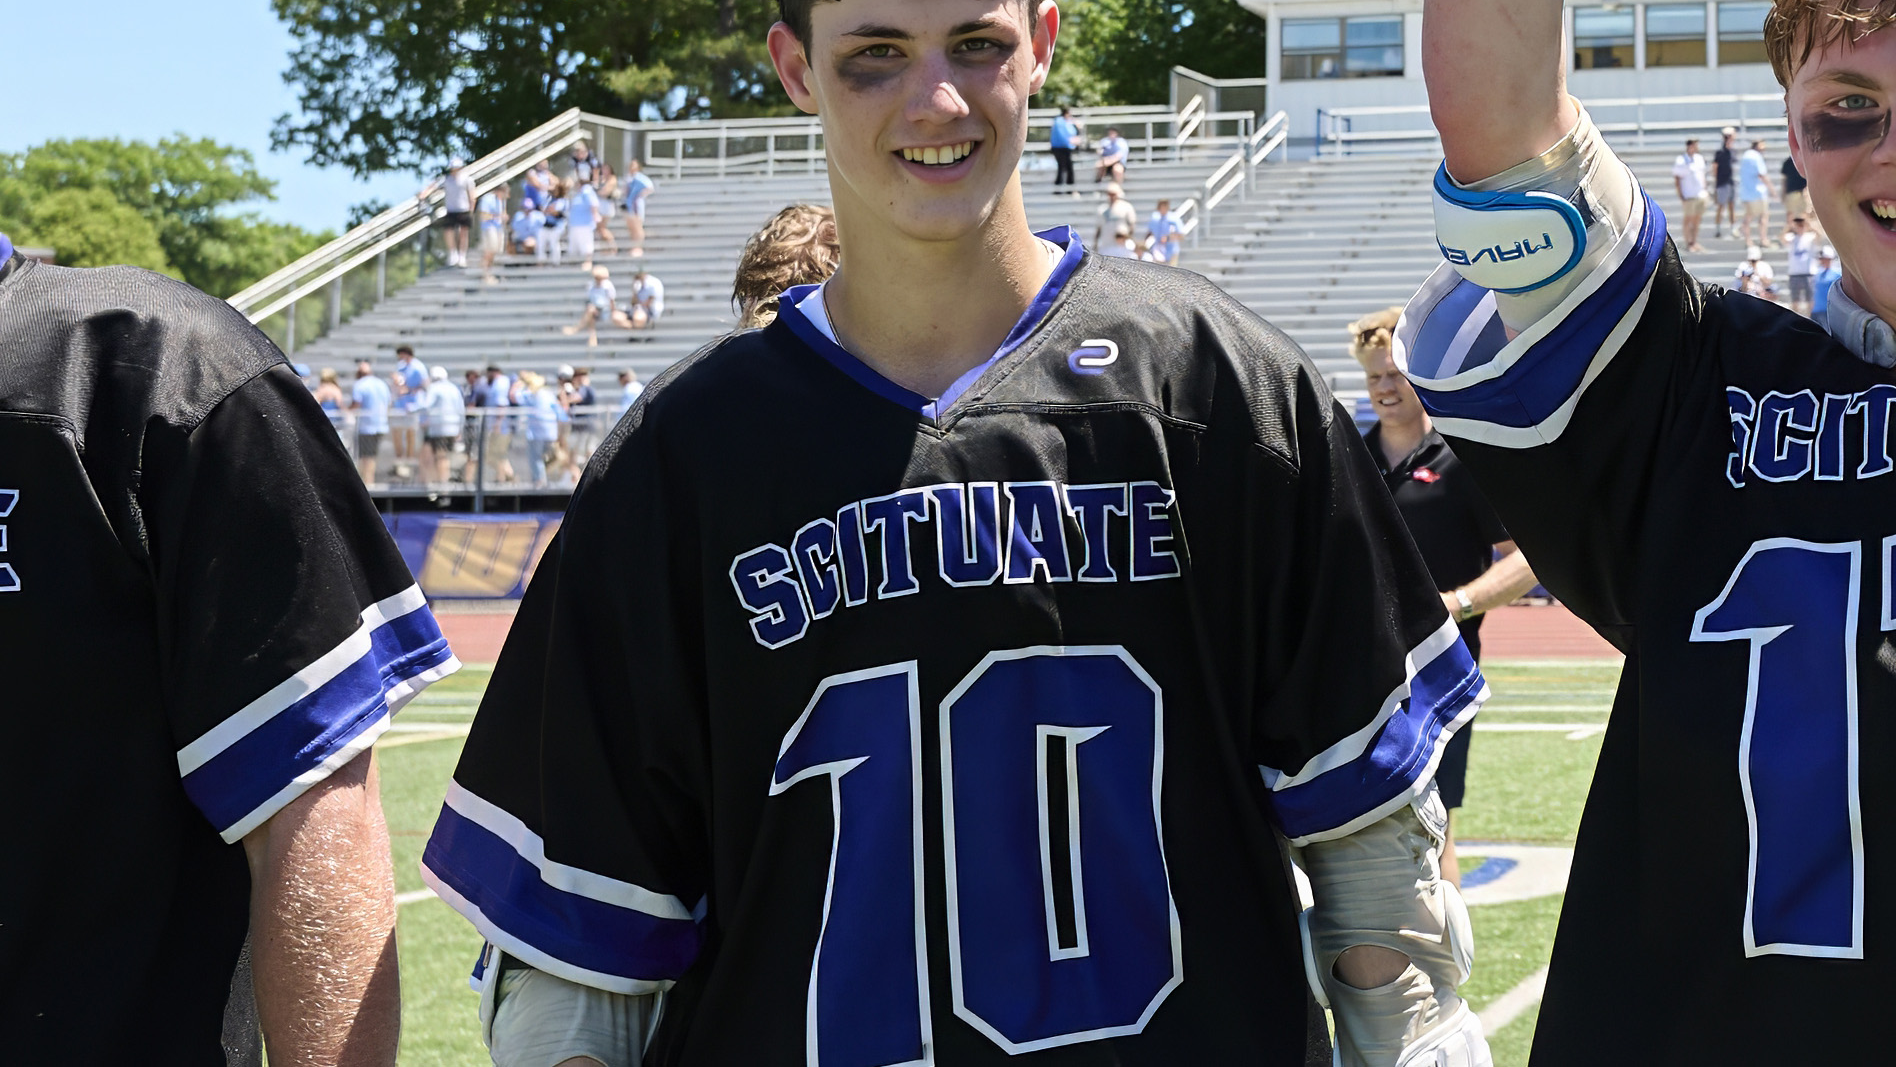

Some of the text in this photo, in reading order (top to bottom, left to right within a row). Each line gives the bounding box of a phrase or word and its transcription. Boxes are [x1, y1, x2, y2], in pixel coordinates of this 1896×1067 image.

[1438, 233, 1553, 266] MAVE
[728, 481, 1181, 650] SCITUATE
[768, 644, 1184, 1067] 10
